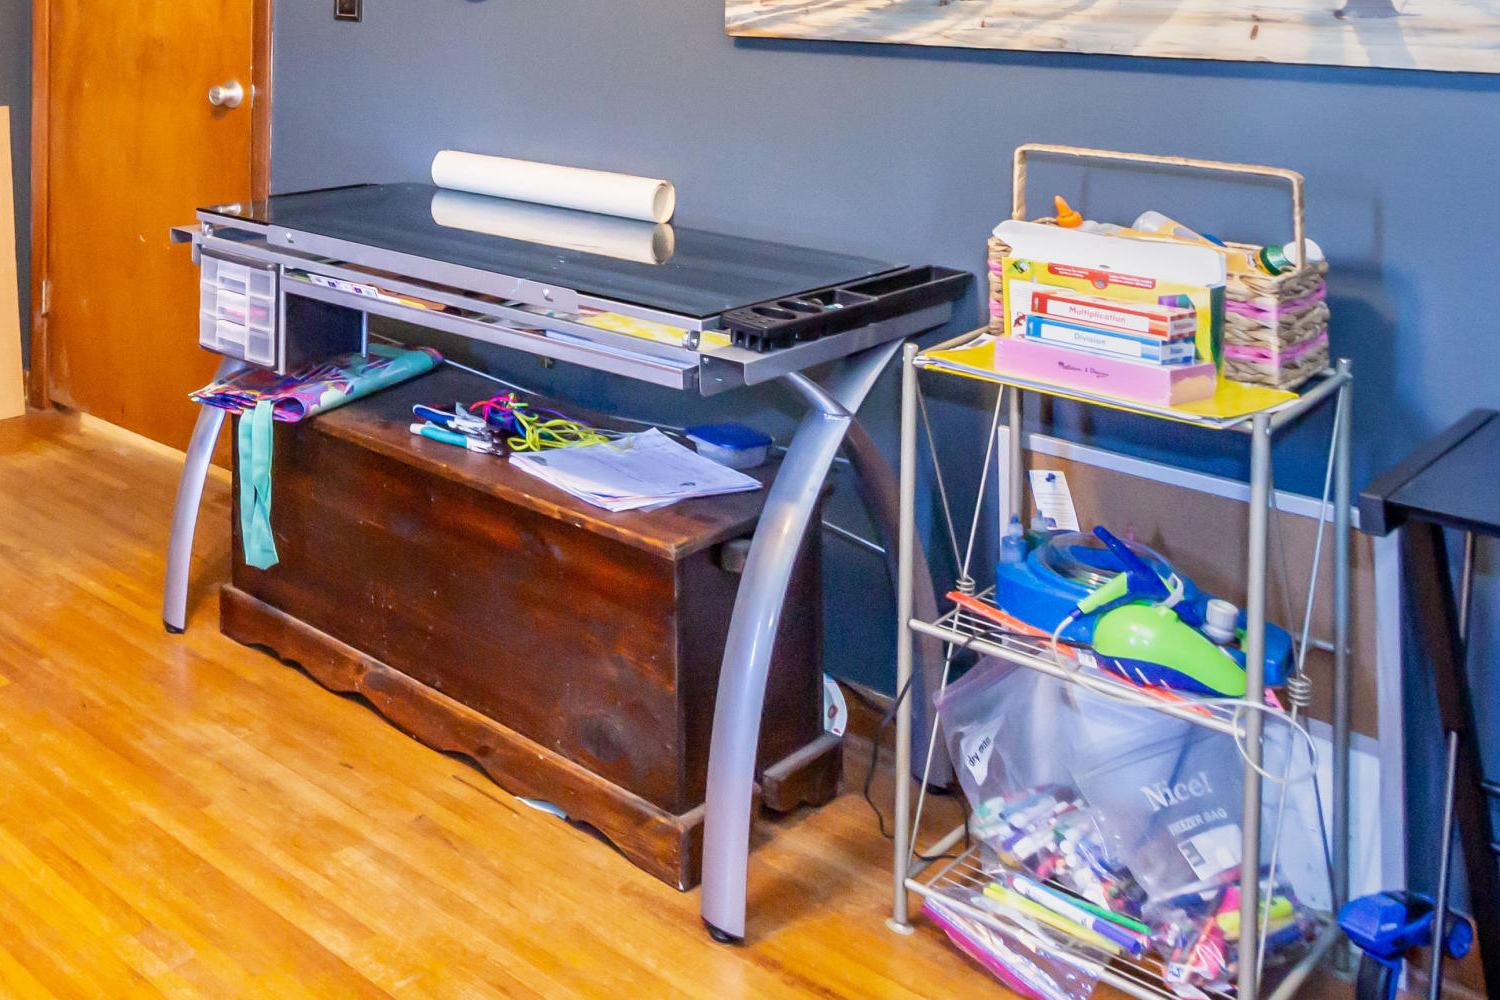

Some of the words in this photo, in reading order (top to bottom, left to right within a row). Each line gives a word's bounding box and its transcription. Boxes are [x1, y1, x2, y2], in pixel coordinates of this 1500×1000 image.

[1068, 305, 1127, 324] Multiplication
[1074, 332, 1106, 346] Division
[1140, 771, 1213, 811] Nice!
[1203, 808, 1227, 822] BAG
